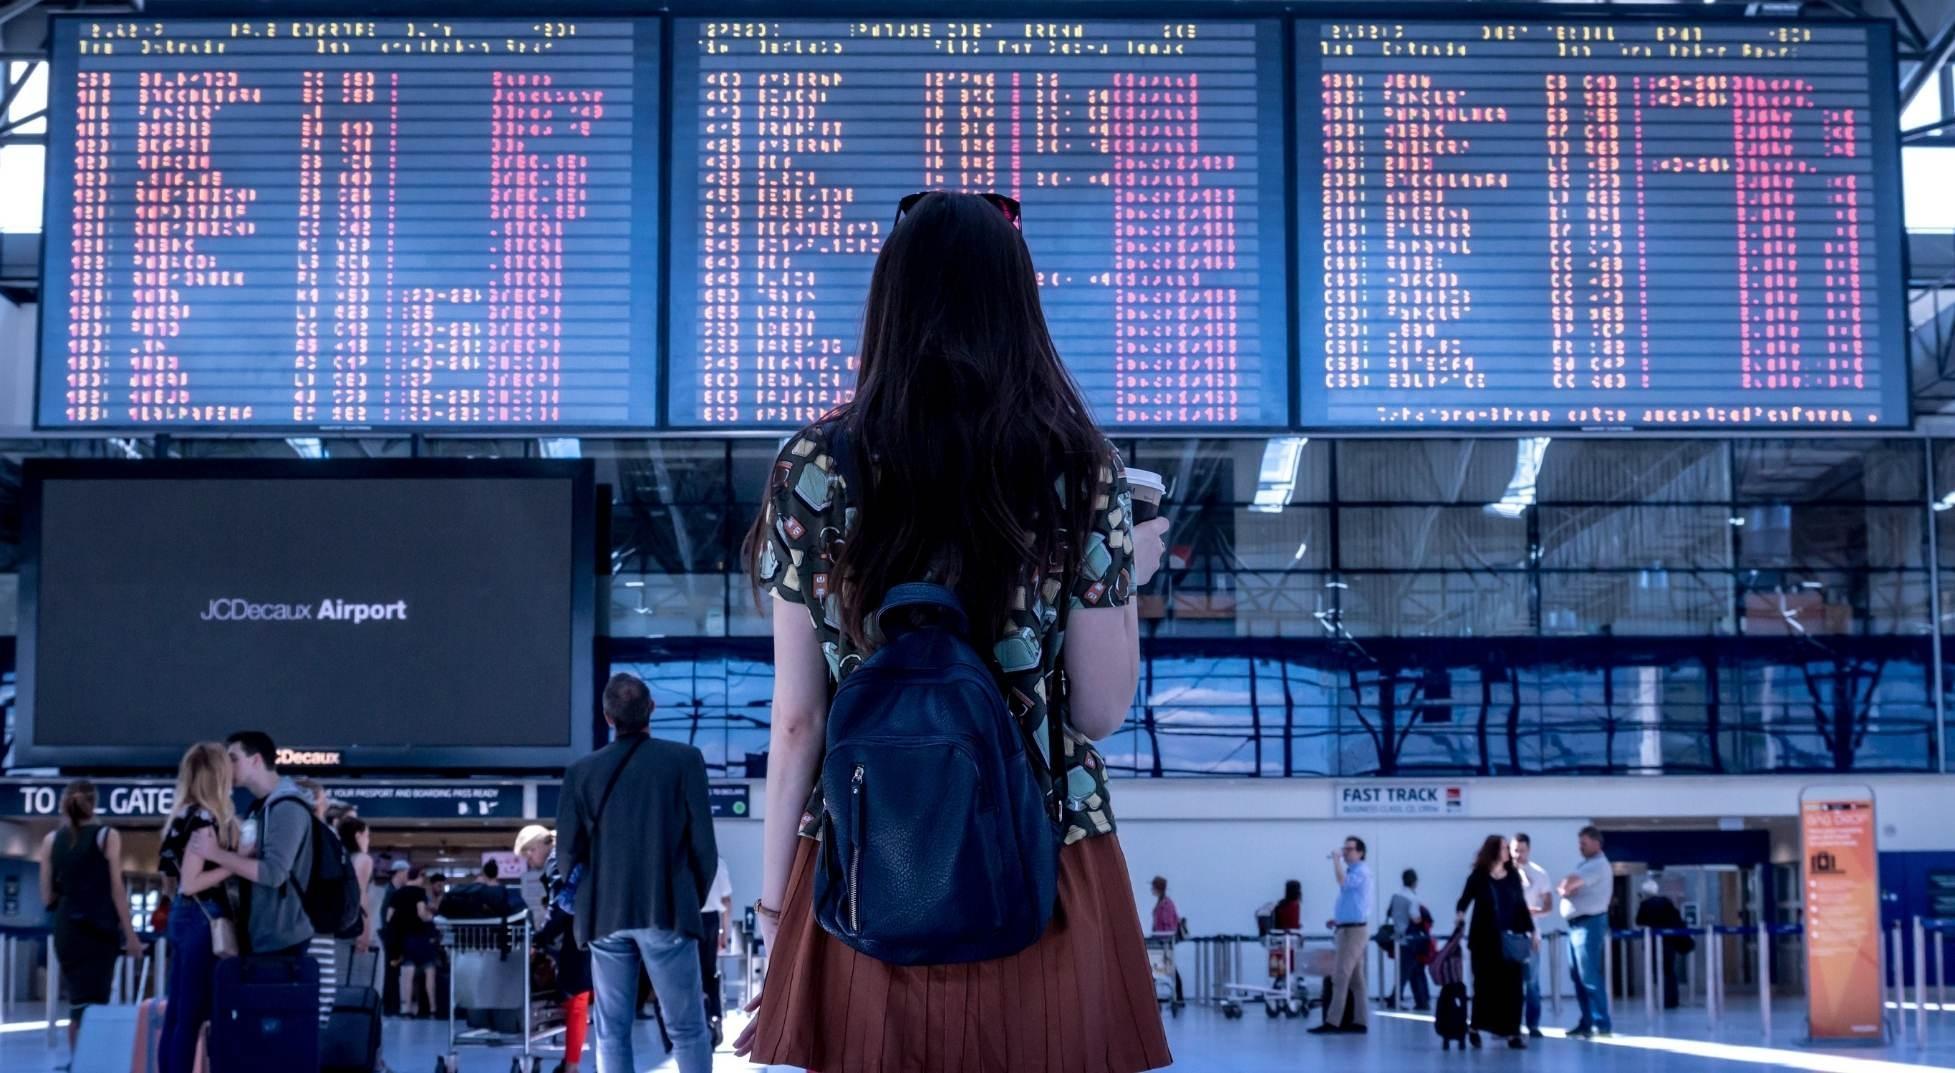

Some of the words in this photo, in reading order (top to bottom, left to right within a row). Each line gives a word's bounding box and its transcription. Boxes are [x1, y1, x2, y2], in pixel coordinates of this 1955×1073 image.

[200, 599, 312, 620] JCDecaux
[317, 599, 407, 624] Airport
[20, 787, 55, 814] TO
[110, 787, 173, 814] GATE
[334, 789, 354, 798] YOUR
[355, 789, 394, 798] PASSPORT
[395, 789, 411, 798] AND
[413, 789, 451, 798] BOARDING
[453, 789, 472, 798] PASS
[473, 789, 499, 798] READY
[1343, 788, 1380, 802] FAST
[1387, 788, 1437, 802] TRACK
